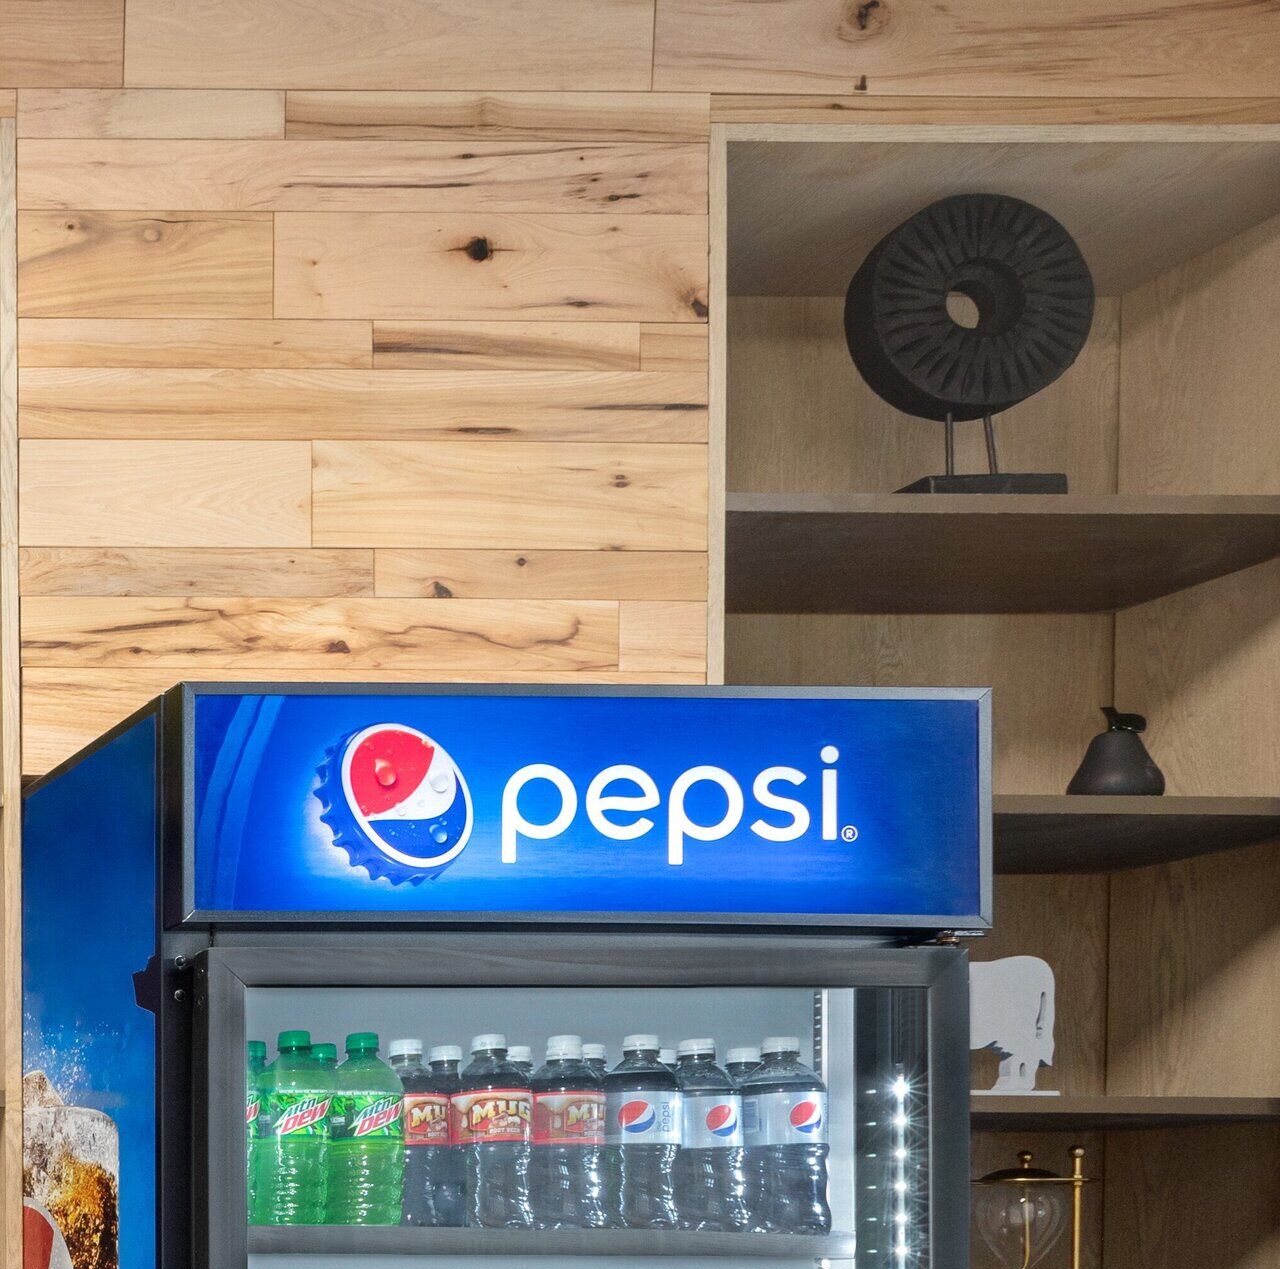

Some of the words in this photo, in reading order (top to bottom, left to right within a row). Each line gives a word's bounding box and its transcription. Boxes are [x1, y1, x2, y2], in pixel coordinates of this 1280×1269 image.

[501, 744, 839, 866] pepsi
[412, 1104, 446, 1126] MU
[472, 1100, 531, 1125] MUG
[567, 1103, 605, 1125] MU
